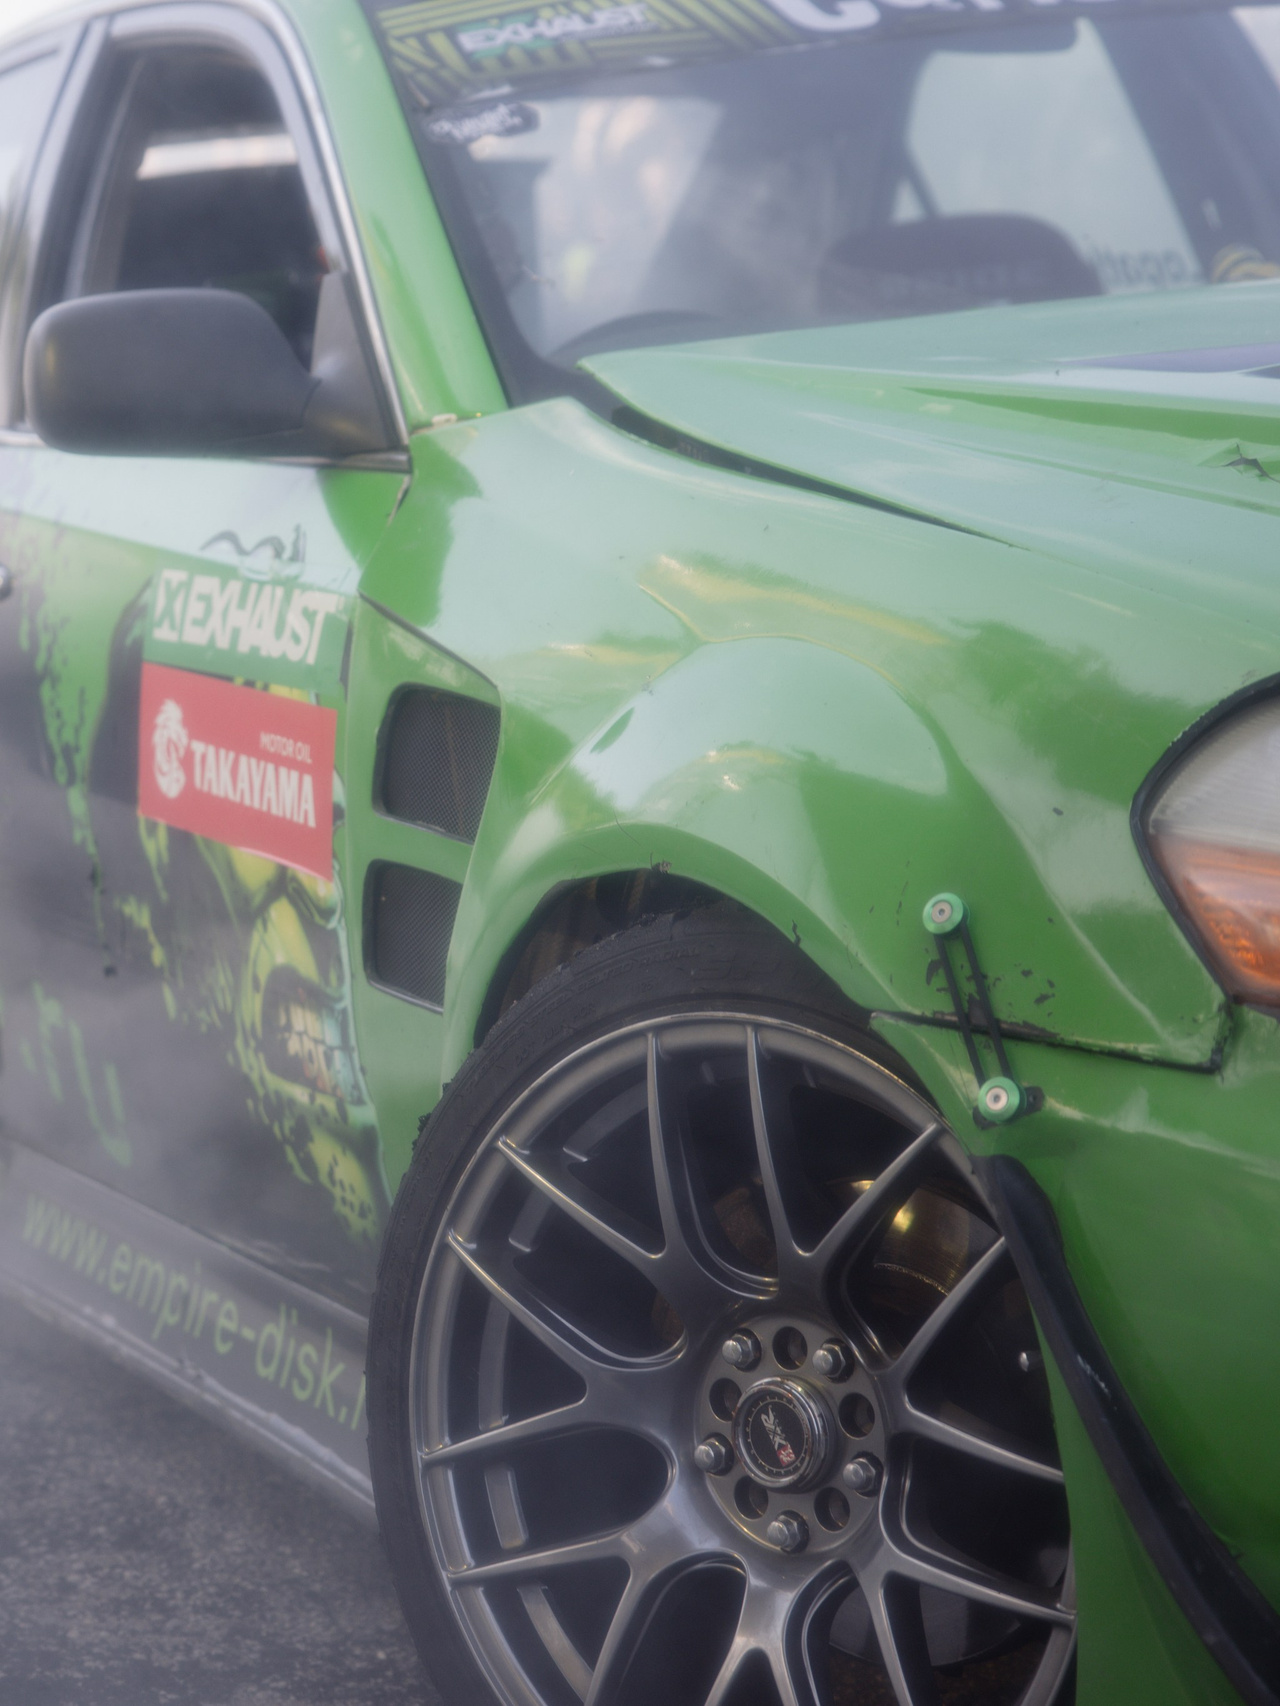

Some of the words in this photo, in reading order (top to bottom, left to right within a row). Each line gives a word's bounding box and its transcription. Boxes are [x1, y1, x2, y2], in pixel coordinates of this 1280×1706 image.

[457, 3, 648, 53] EXHAUST
[181, 574, 340, 666] EXHAUST
[260, 731, 294, 757] MOTOR
[294, 741, 313, 764] OIL
[190, 739, 317, 829] TAKAYAMA
